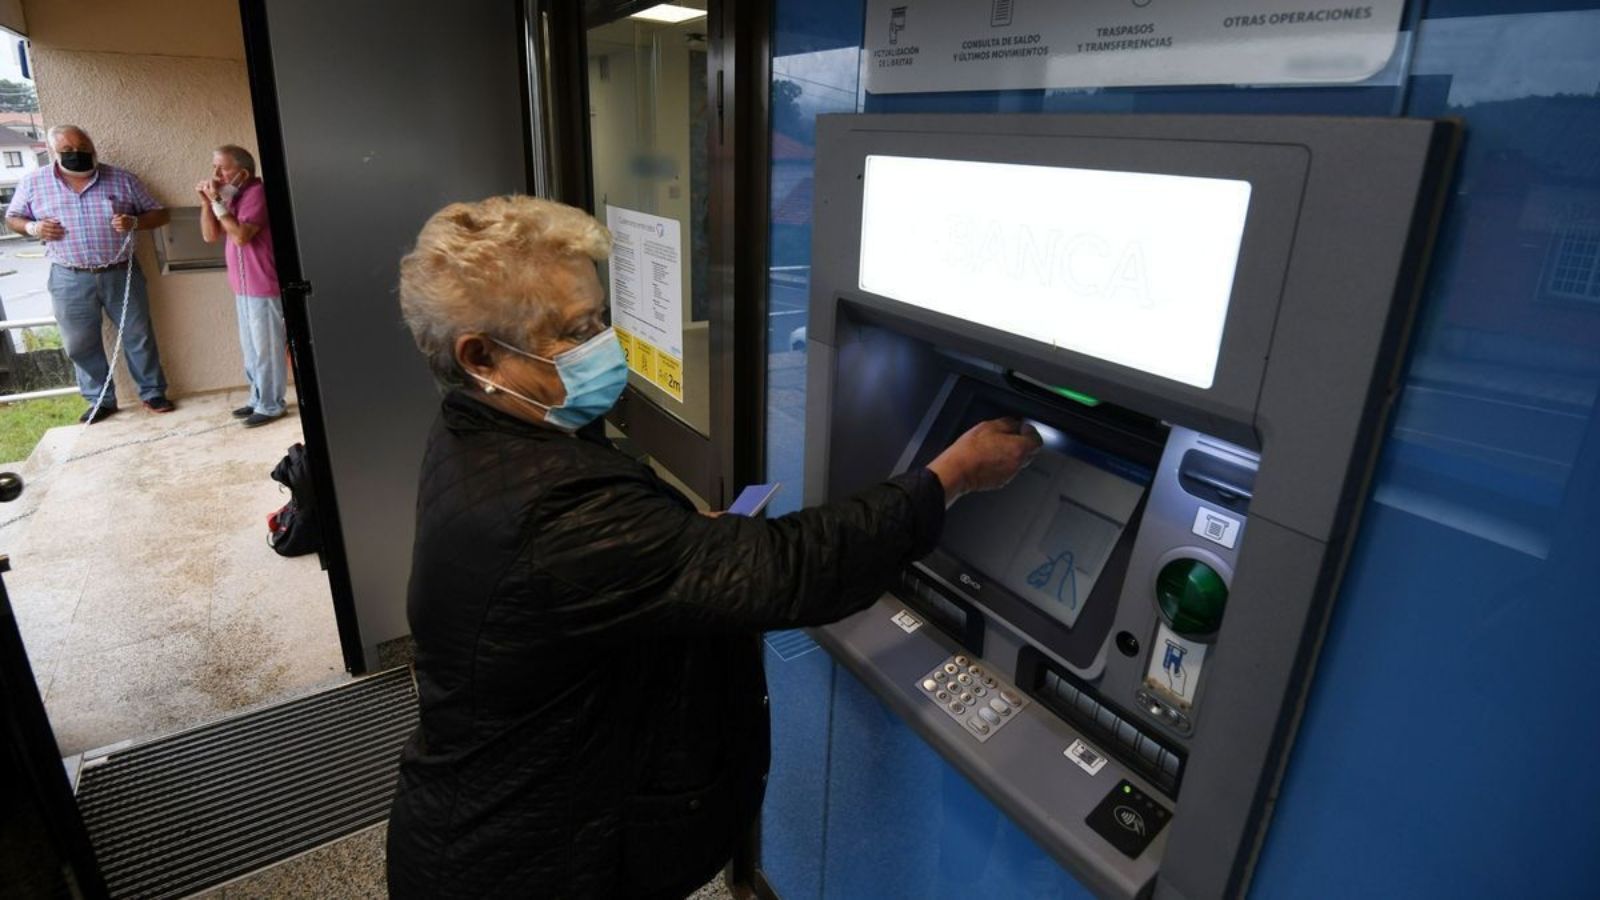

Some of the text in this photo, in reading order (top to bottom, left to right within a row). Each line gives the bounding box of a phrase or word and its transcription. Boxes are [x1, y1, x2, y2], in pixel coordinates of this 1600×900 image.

[1223, 6, 1373, 28] OTRAS OPERACIONES
[1096, 23, 1154, 37] TRASPASOS
[962, 34, 1041, 50] CONSULTA DE SALDO
[1077, 36, 1173, 53] Y TRANSFERENCIAS
[991, 46, 1049, 59] MOVIMIENTOS
[668, 374, 681, 392] 2m
